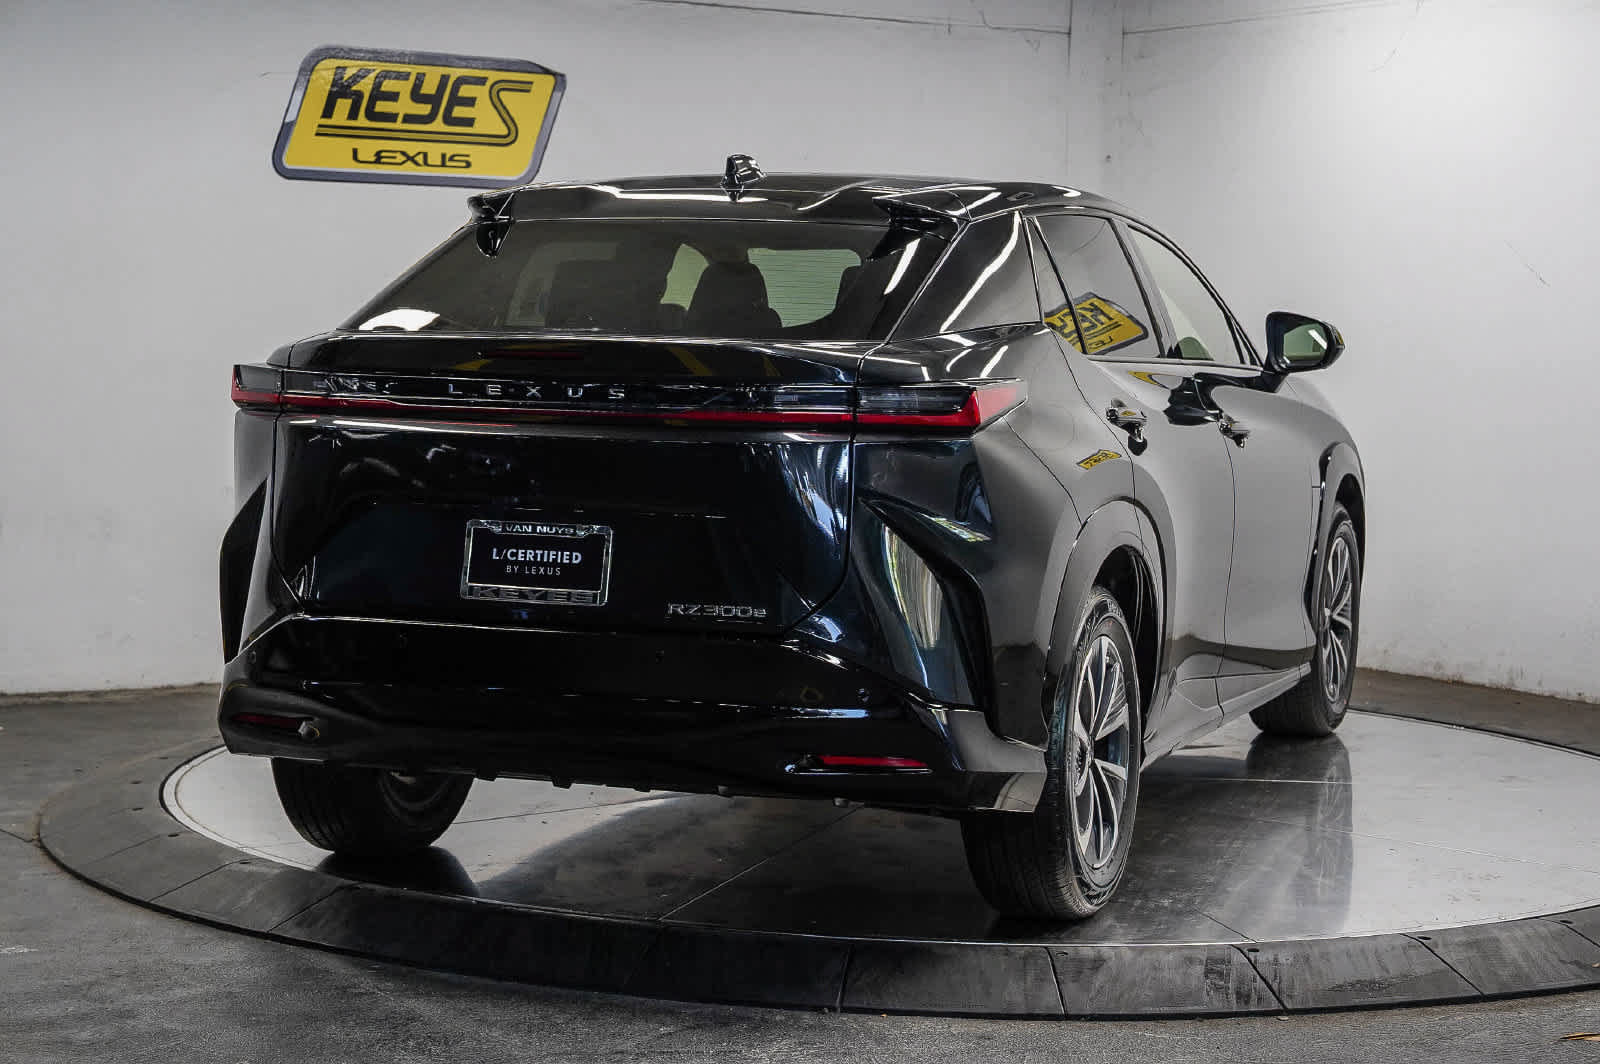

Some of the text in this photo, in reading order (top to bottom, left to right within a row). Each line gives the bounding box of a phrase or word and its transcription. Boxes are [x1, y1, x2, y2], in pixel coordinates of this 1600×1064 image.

[315, 66, 534, 147] KEYES
[352, 147, 472, 169] LEXUS
[448, 383, 626, 399] LEXUS
[505, 524, 576, 535] VAN NUYS
[491, 547, 583, 564] L/CERTIFIED
[505, 564, 562, 576] BY LEXUS
[667, 602, 768, 618] RZ300e
